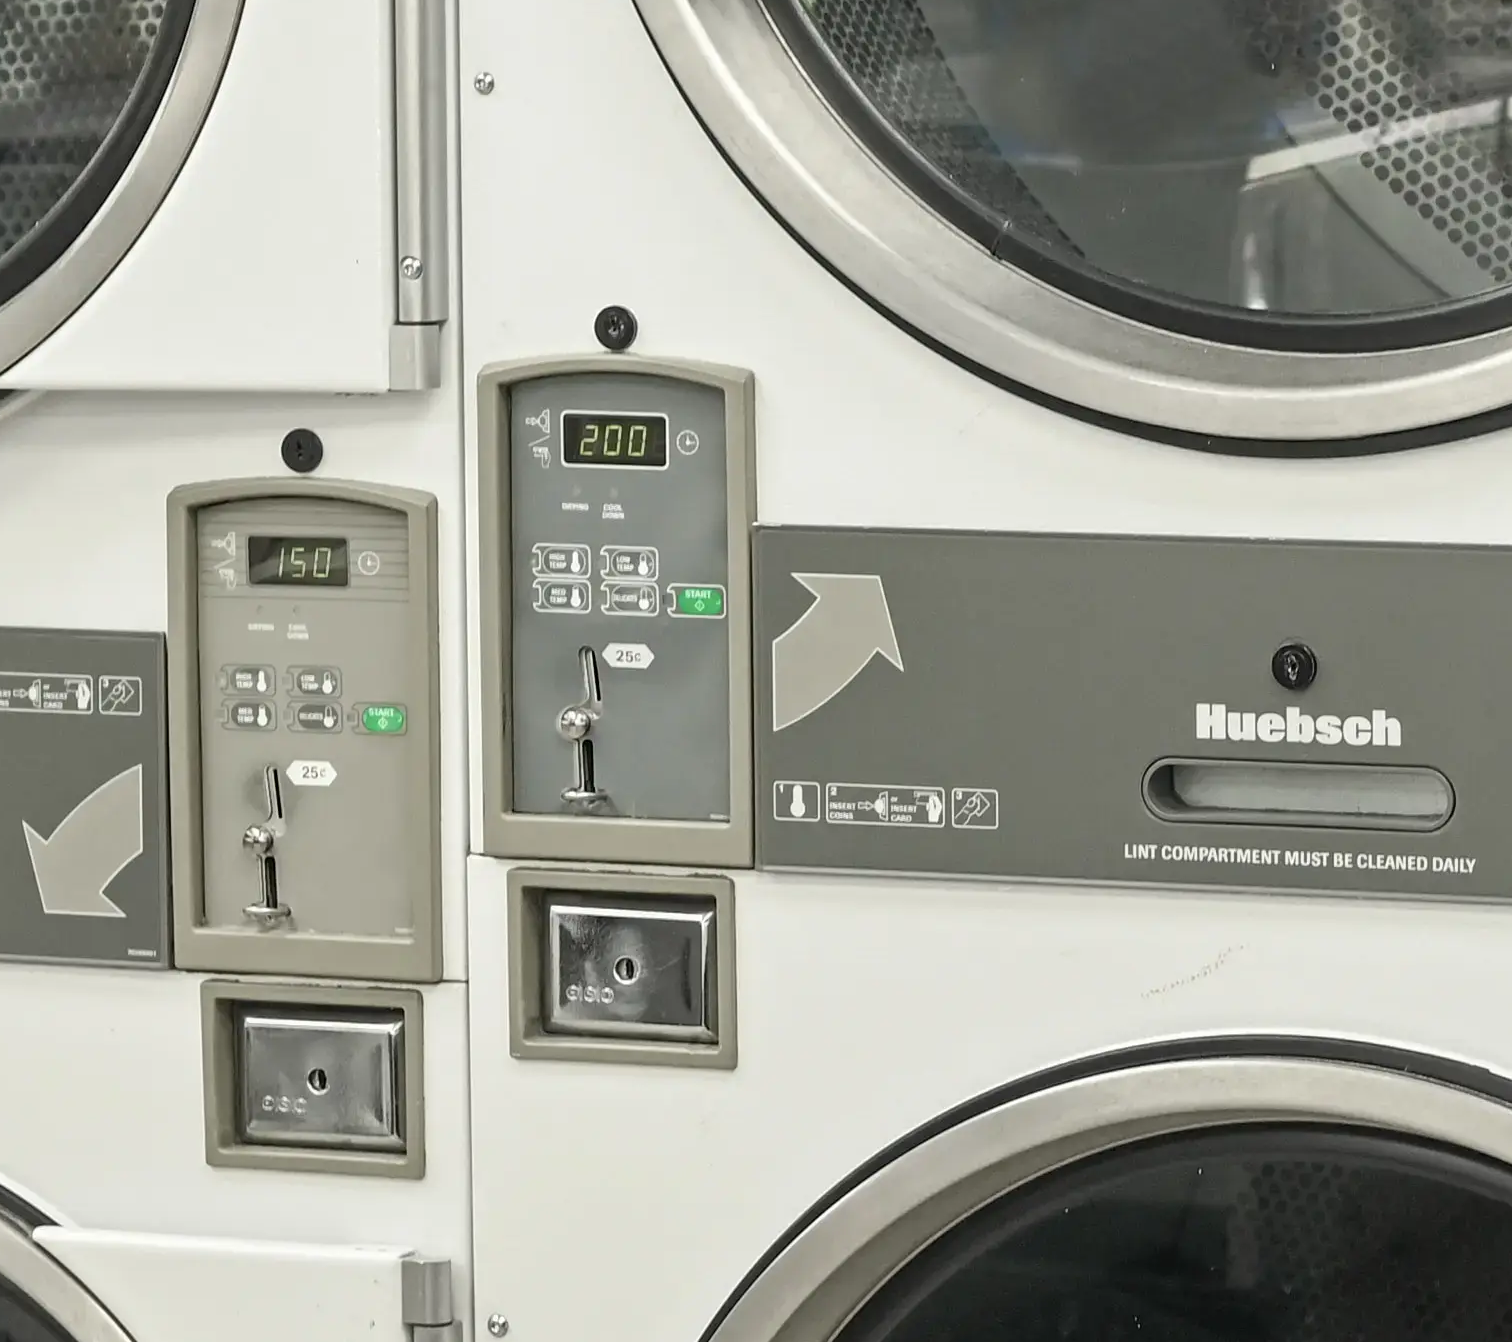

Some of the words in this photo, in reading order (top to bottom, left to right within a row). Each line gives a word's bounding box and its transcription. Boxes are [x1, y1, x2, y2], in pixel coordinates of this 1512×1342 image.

[580, 424, 647, 457] 200
[278, 547, 331, 578] 150
[685, 589, 711, 599] START
[368, 708, 394, 717] START
[1196, 703, 1401, 746] Huebsch
[1124, 843, 1157, 860] LINT
[1161, 845, 1281, 865] COMPARTMENT
[1284, 850, 1330, 867] MUST
[1333, 852, 1353, 868] BE
[1357, 853, 1428, 872] CLEANED
[1432, 857, 1476, 874] DAILY
